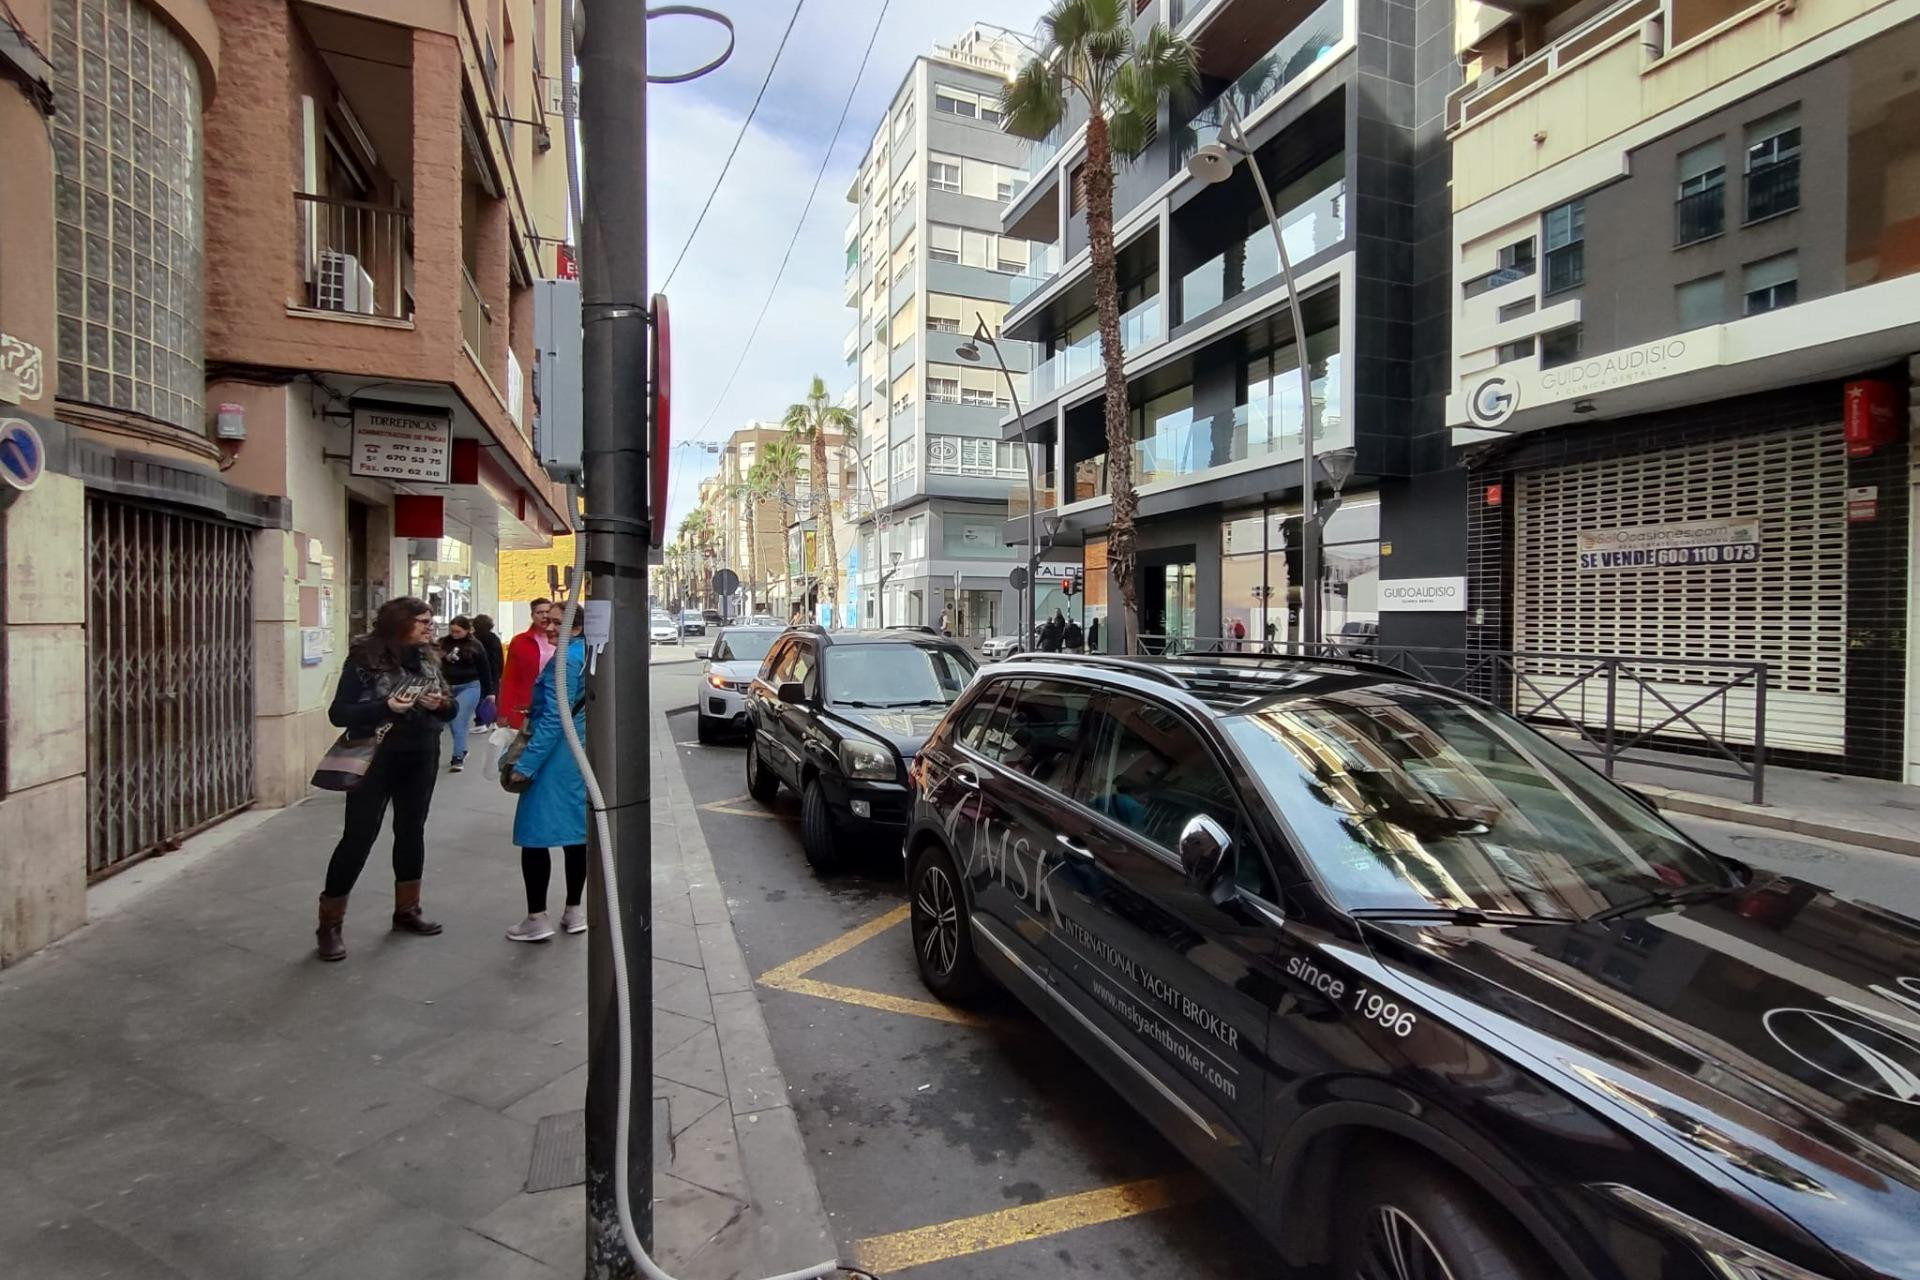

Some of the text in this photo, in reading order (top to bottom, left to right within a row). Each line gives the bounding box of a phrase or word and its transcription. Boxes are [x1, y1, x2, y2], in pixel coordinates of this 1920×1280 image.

[1541, 340, 1686, 389] GUIDO AUDISIO
[370, 415, 437, 431] TORREFINCAS
[383, 466, 403, 474] 670
[1580, 545, 1755, 568] SE VENDE 600 110 073
[980, 817, 1066, 930] MSK
[1065, 917, 1238, 1050] INTERNATIONAL YACHT BROKER
[1287, 957, 1416, 1037] since 1996
[1093, 979, 1236, 1100] www.mskyachtbroker.com
